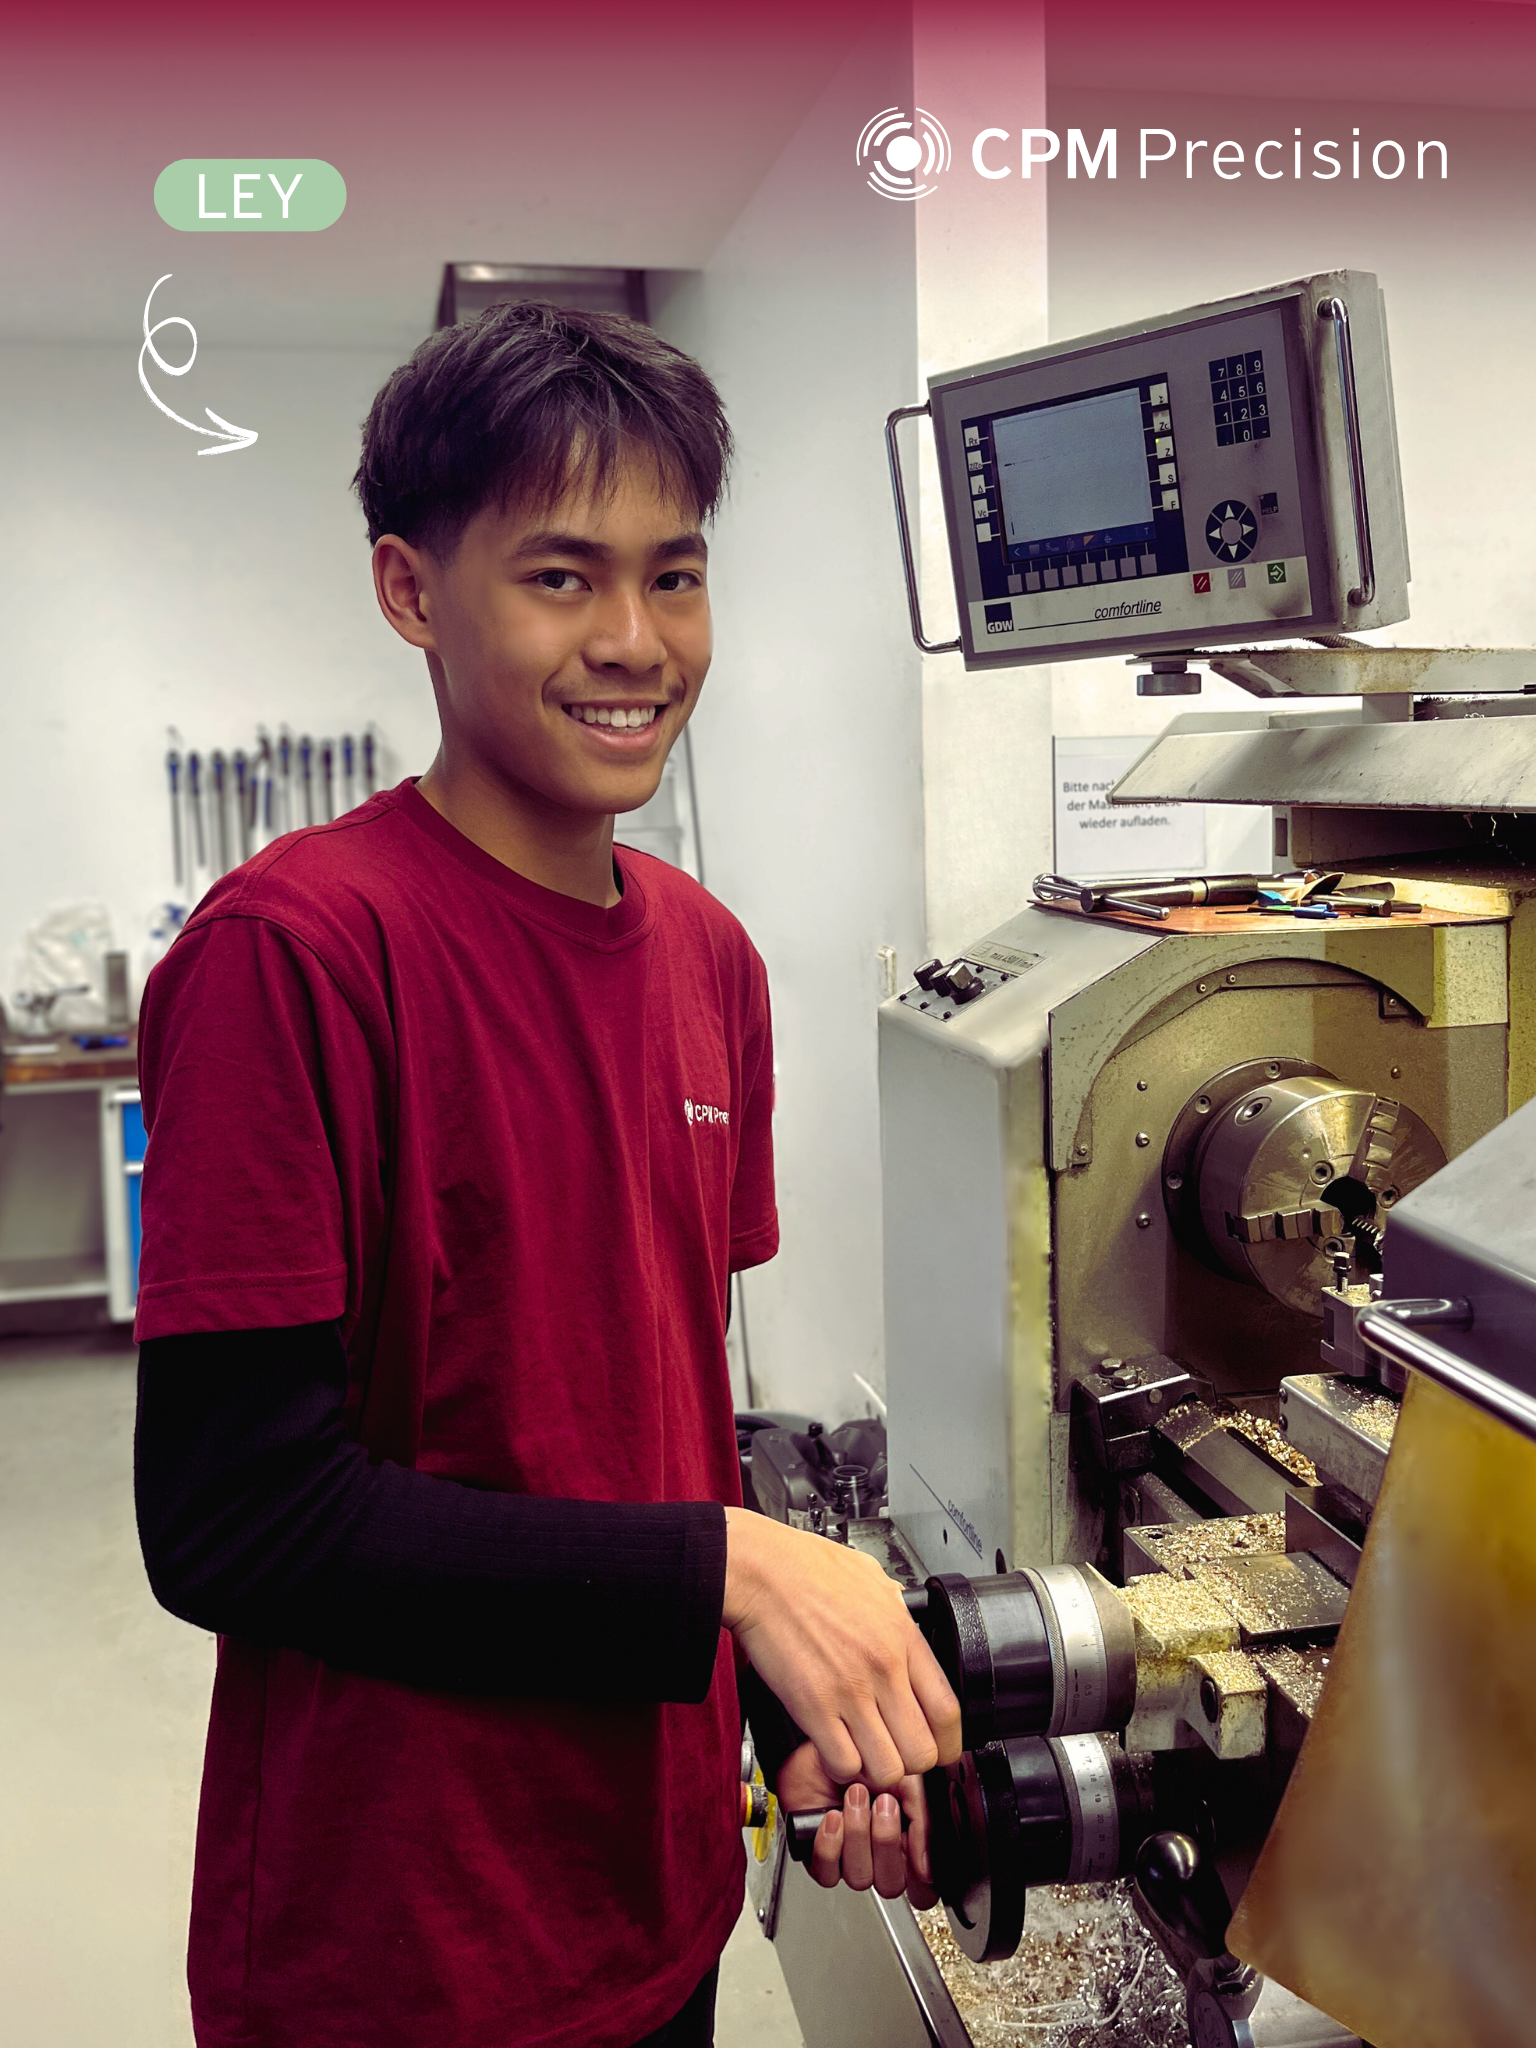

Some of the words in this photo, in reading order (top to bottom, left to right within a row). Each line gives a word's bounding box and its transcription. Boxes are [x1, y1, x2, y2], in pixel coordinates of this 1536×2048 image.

[1218, 368, 1224, 377] 7
[1236, 364, 1243, 375] 8
[1253, 359, 1261, 371] 9
[1220, 390, 1227, 400] 4
[1238, 386, 1246, 397] 5
[1256, 382, 1264, 393] 6
[1223, 412, 1229, 422] 1
[1240, 408, 1248, 420] 2
[1259, 404, 1266, 415] 3
[969, 437, 978, 446] Rx
[1243, 429, 1250, 441] 0
[1165, 448, 1171, 457] Z
[1167, 474, 1174, 483] S
[1170, 500, 1176, 509] F
[1261, 506, 1278, 514] HELP
[1094, 599, 1162, 619] comfortline
[987, 620, 1013, 633] GDW
[1063, 781, 1090, 793] Bitte
[1092, 779, 1115, 792] nac
[1067, 801, 1086, 812] der
[1080, 817, 1118, 829] wieder
[1120, 815, 1171, 828] aufladen.
[947, 1499, 983, 1553] comfortline
